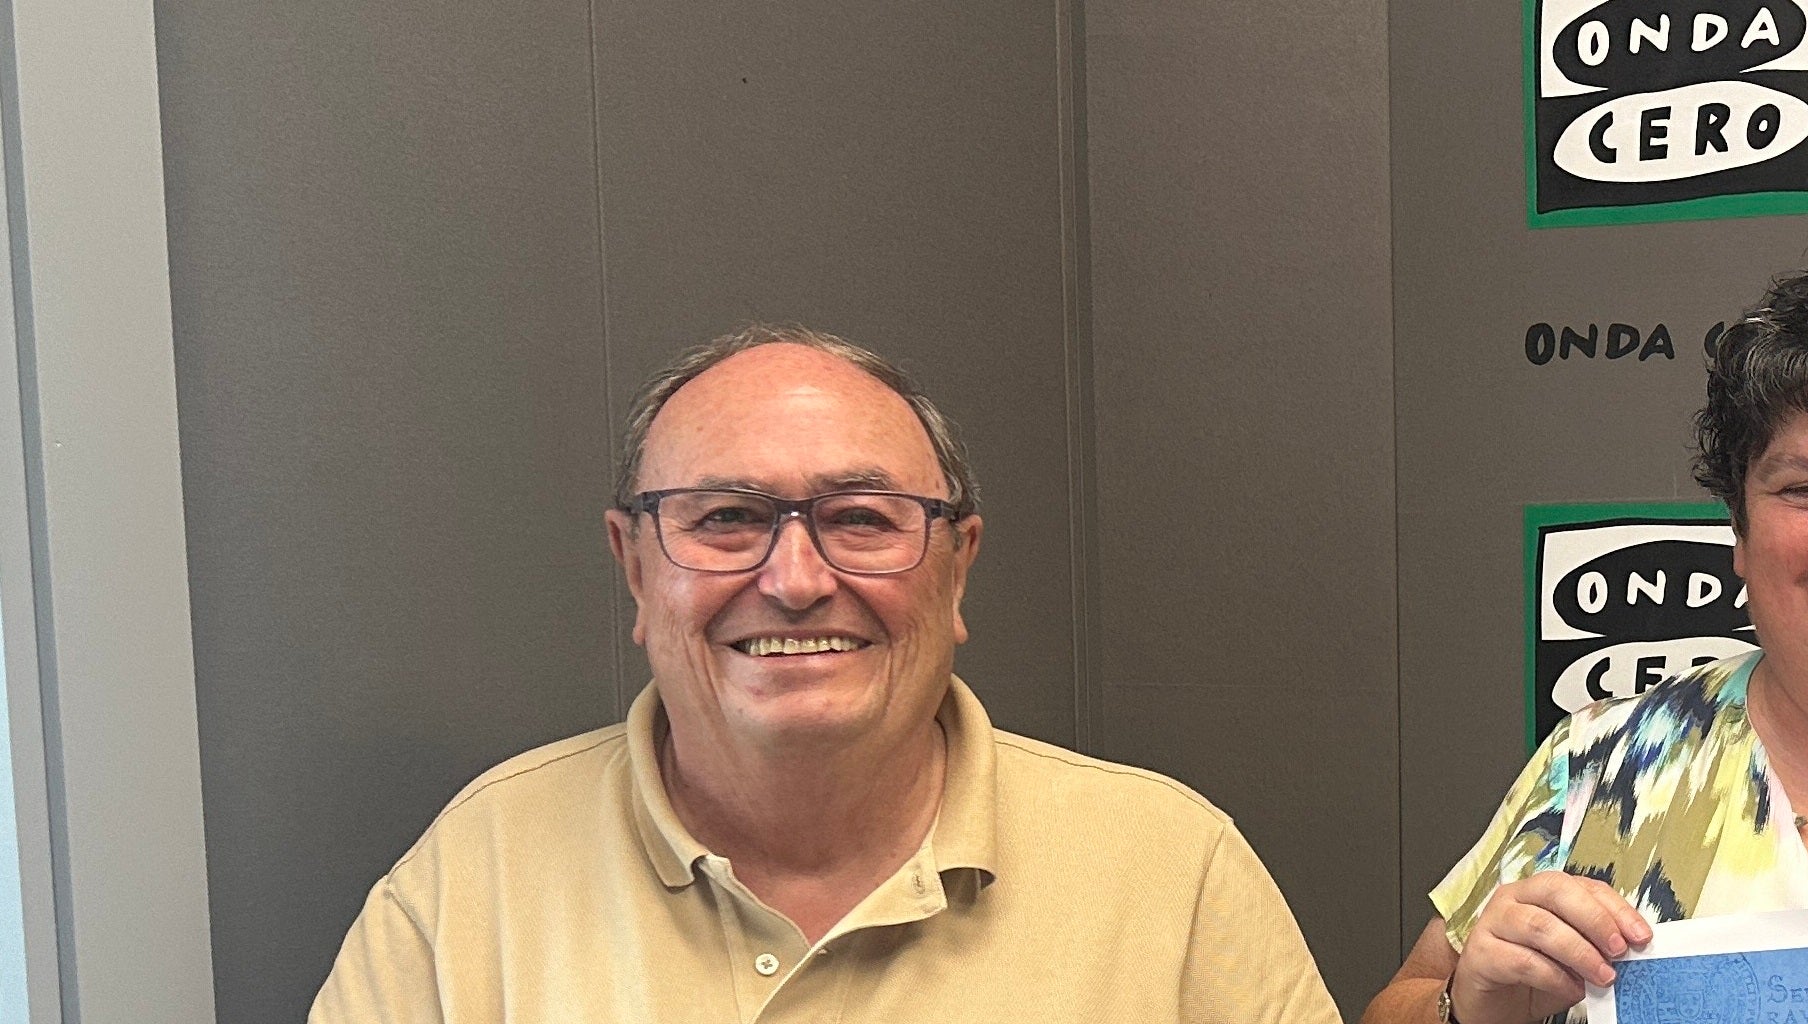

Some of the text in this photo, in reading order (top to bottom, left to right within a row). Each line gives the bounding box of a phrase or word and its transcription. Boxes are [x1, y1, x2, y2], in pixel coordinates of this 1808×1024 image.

[1577, 7, 1781, 66] ONDA
[1589, 102, 1781, 163] CERO
[1525, 322, 1675, 365] ONDA
[1576, 569, 1748, 614] OND
